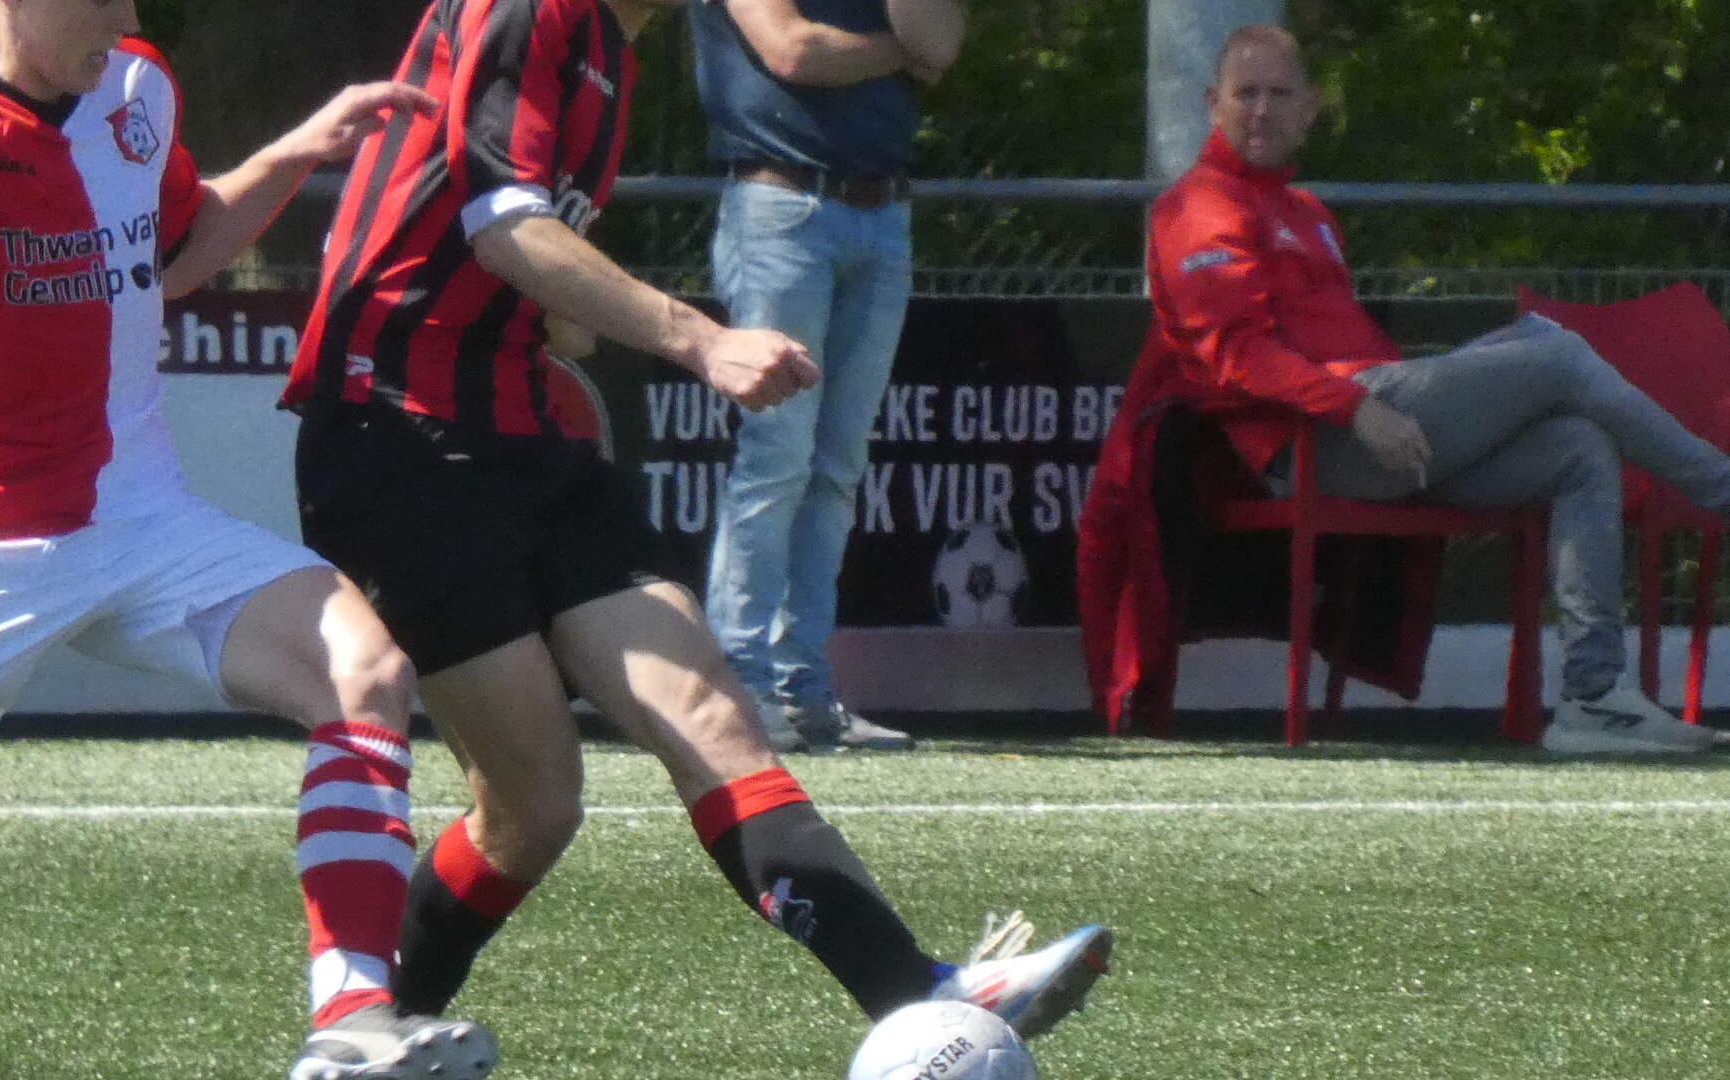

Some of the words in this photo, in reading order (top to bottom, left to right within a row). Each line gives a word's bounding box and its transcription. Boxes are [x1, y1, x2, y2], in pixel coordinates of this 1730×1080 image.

[4, 262, 124, 306] Gennip
[646, 383, 732, 440] VUR
[952, 385, 1058, 441] CLUB
[911, 463, 1013, 532] VUR
